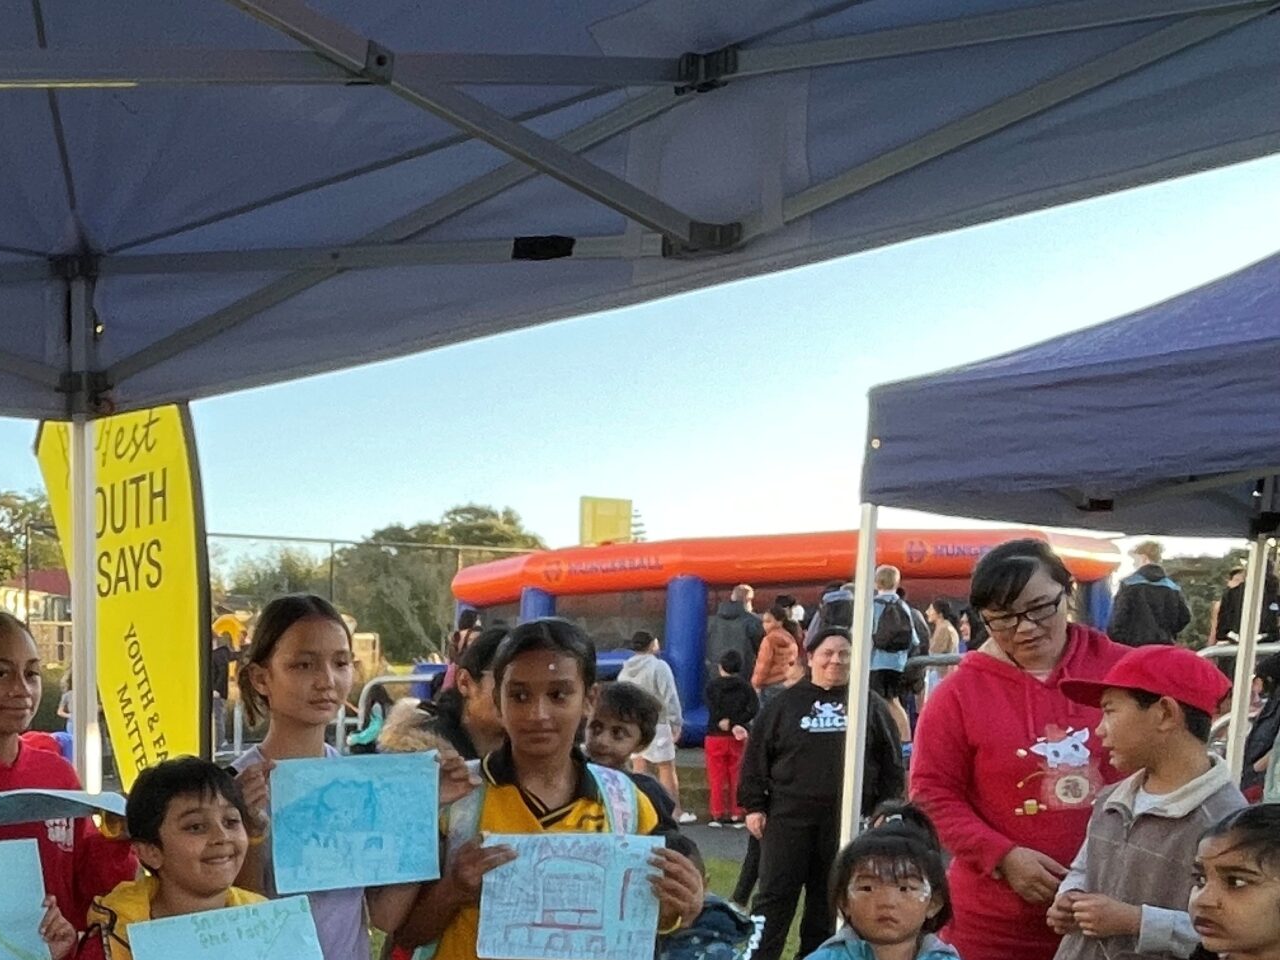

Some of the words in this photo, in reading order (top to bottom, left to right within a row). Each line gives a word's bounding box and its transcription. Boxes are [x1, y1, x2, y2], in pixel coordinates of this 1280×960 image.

[95, 467, 167, 538] OUTH
[97, 539, 162, 597] SAYS
[124, 622, 155, 711] YOUTH
[147, 712, 160, 733] &
[117, 682, 148, 772] MATTE
